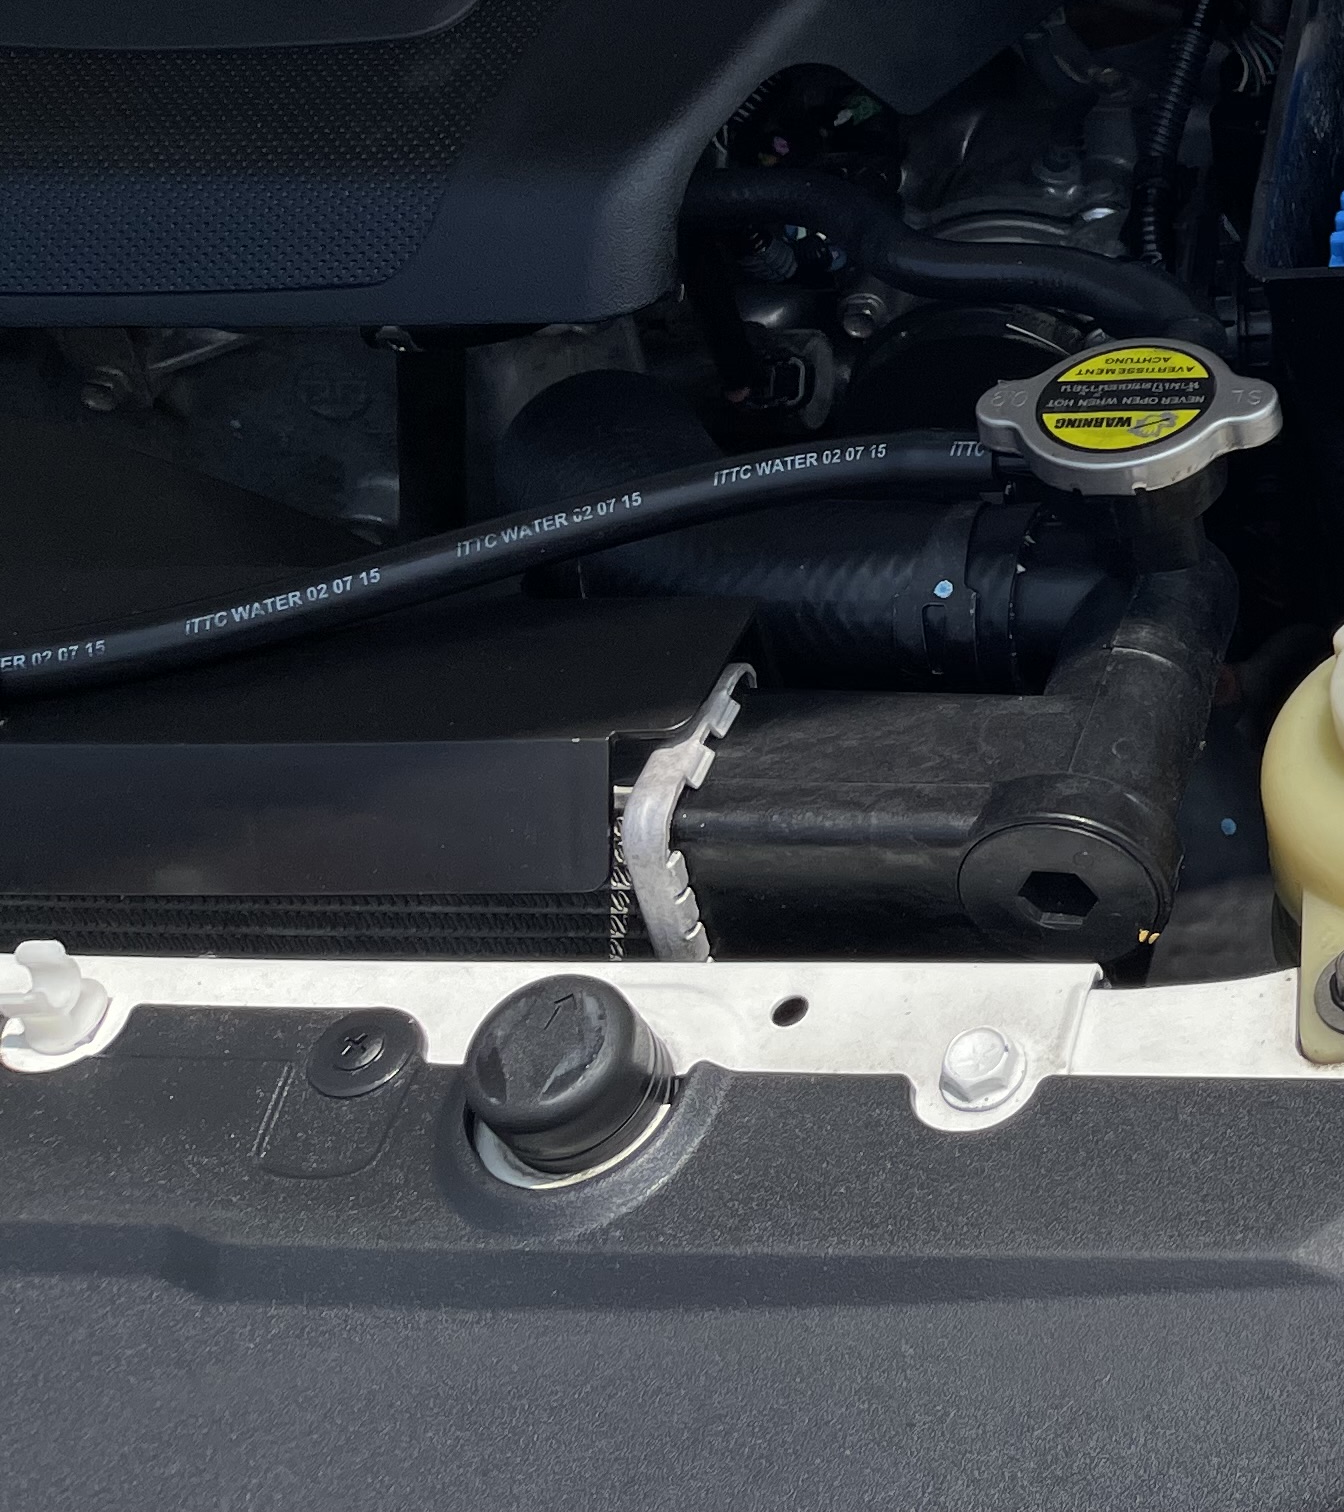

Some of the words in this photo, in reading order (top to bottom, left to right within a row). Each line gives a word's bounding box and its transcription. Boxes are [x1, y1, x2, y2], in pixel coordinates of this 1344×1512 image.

[1104, 356, 1172, 365] ACHTUNG
[1075, 365, 1195, 376] AVERTISSEMENT
[1045, 398, 1075, 408] HOT
[1078, 397, 1118, 407] WHEN
[1121, 396, 1159, 405] OPEN
[1160, 395, 1205, 405] NEVER
[1054, 416, 1132, 430] WARNING
[756, 452, 818, 477] WATER
[822, 448, 842, 465] 02
[845, 445, 864, 462] 07
[868, 443, 888, 460] 15
[500, 512, 569, 544] WATER
[572, 505, 594, 524] 02
[596, 498, 618, 517] 07
[621, 491, 643, 510] 15
[229, 590, 304, 623] WATER
[305, 585, 330, 602] 02
[332, 575, 354, 595] 07
[359, 567, 381, 586] 15
[57, 644, 79, 662] 07
[85, 639, 106, 658] 15
